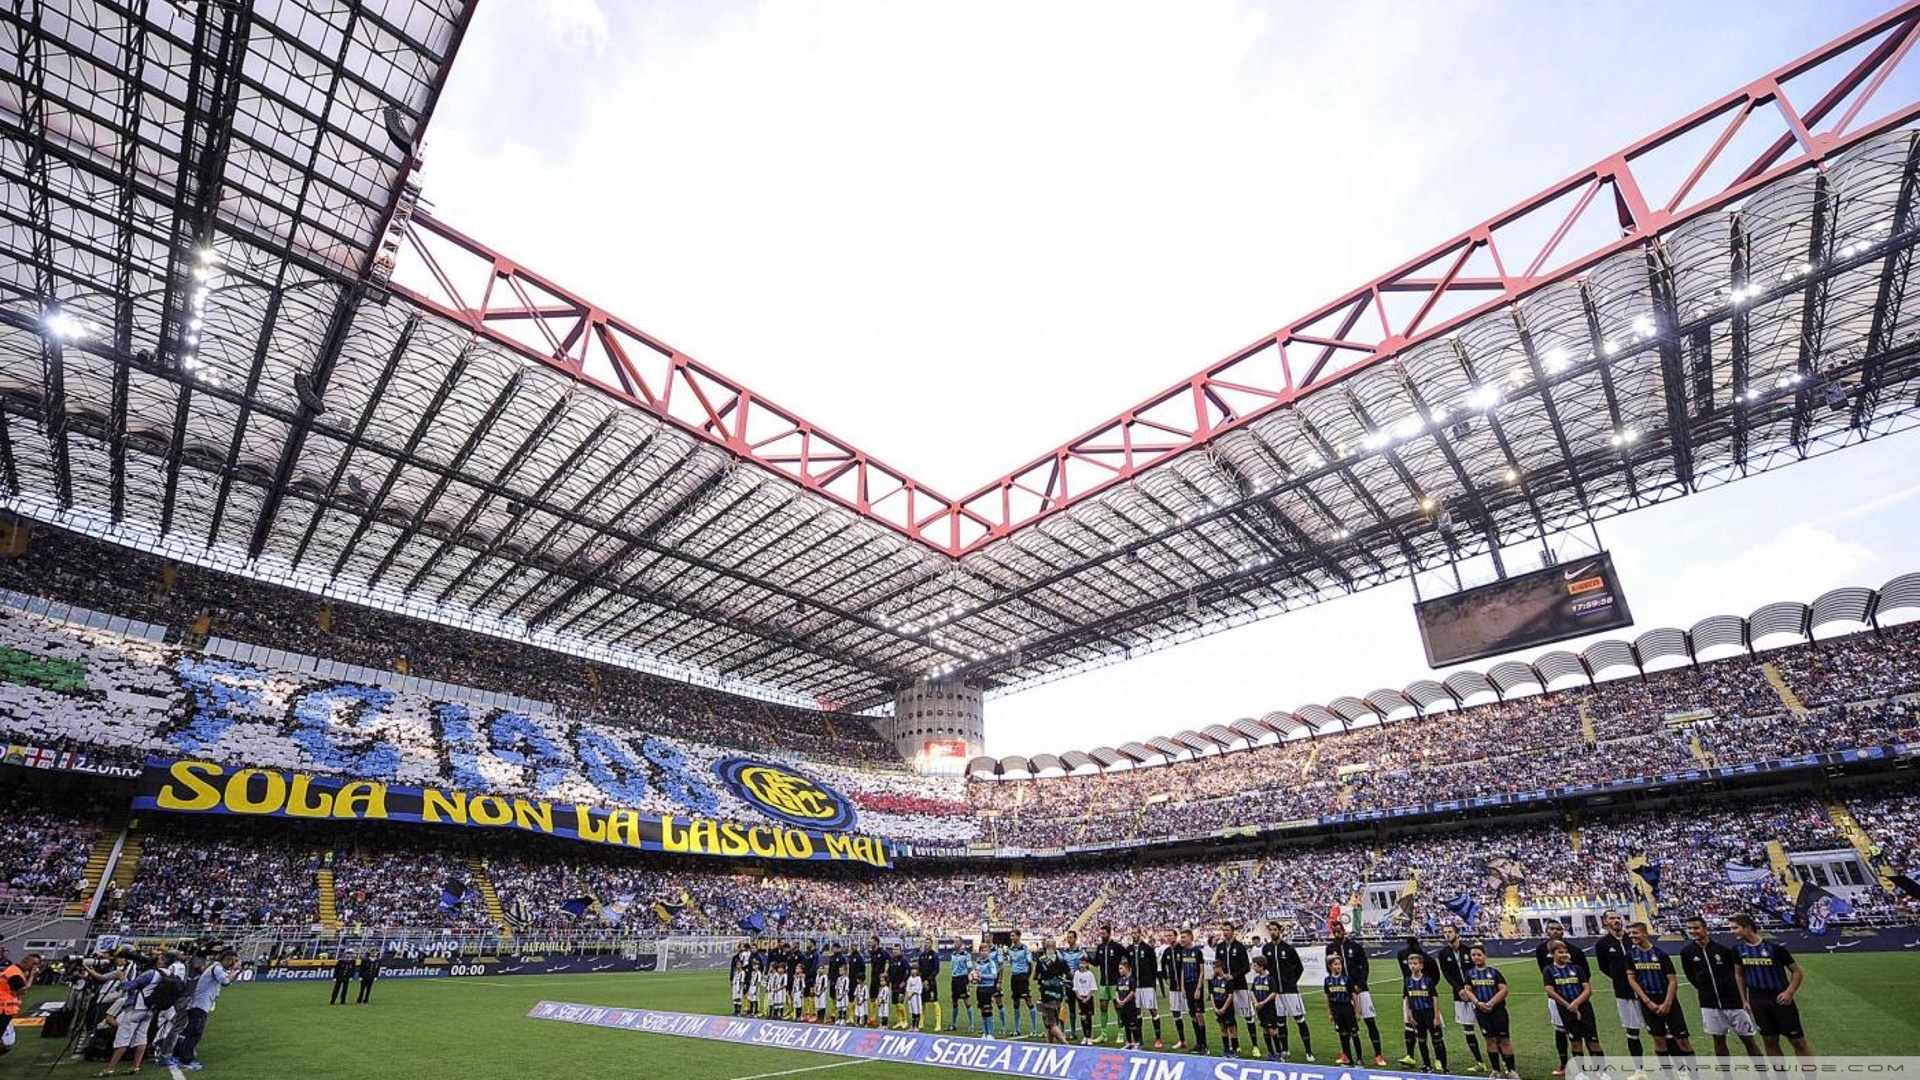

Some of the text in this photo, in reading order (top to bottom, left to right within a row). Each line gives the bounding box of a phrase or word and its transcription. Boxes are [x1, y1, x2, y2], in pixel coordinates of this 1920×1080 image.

[157, 760, 887, 867] SOLA NON LA LASCIO MAI
[451, 964, 485, 976] 00:00
[615, 1011, 639, 1026] TIM
[677, 1015, 707, 1034] TIM
[722, 1022, 749, 1038] TIM
[752, 1023, 796, 1045] SERIE
[790, 1028, 807, 1047] A
[809, 1027, 851, 1050] TIM
[878, 1034, 917, 1057] TIM
[925, 1038, 988, 1068] SERIE
[989, 1046, 1012, 1070] A
[1017, 1046, 1076, 1077] TIM
[1128, 1057, 1185, 1080] TIM
